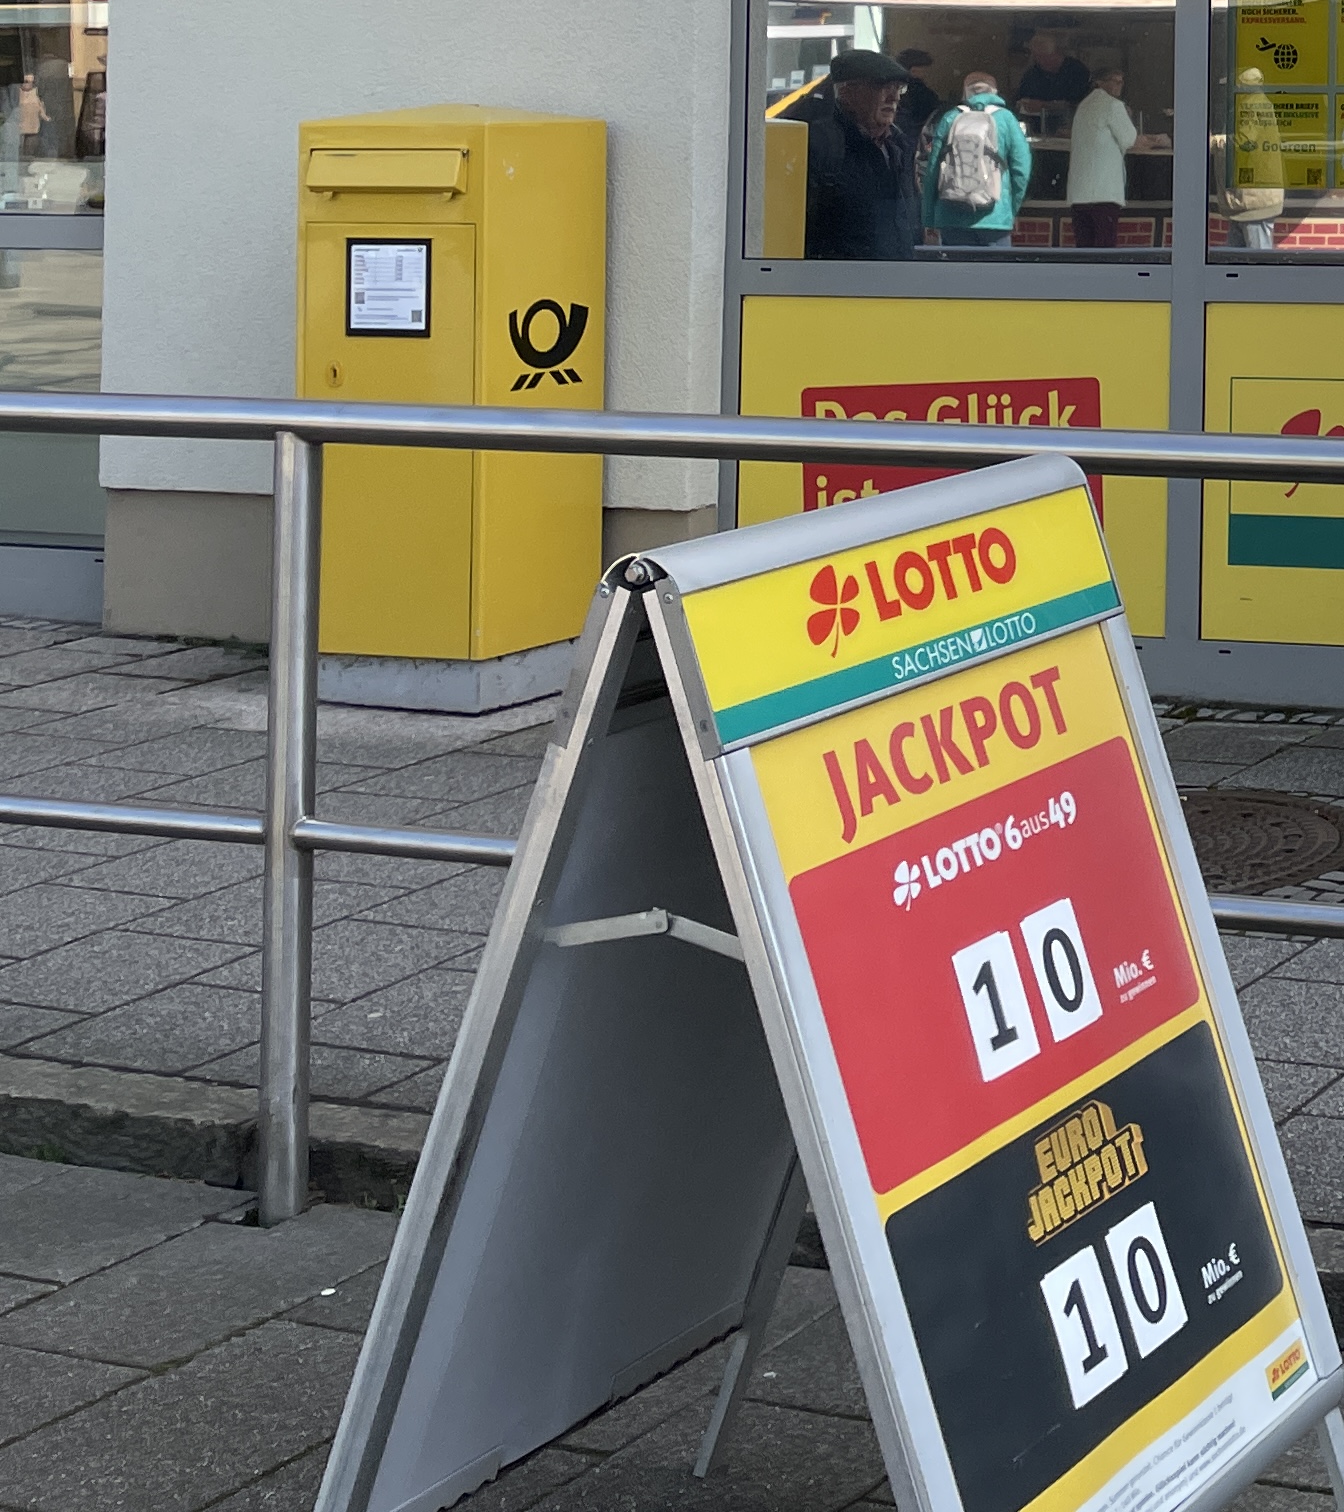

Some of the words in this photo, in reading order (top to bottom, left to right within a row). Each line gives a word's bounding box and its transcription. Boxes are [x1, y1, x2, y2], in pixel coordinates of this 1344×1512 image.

[1262, 141, 1316, 153] GoGreen
[866, 527, 1017, 621] LOTTO
[891, 634, 971, 680] SACHSEN
[986, 612, 1036, 647] LOTTO
[822, 666, 1069, 844] JACKPOT
[1113, 961, 1143, 989] Mio.
[1141, 949, 1154, 970] €
[1034, 1104, 1103, 1185] EURO
[1028, 1131, 1138, 1242] JACKPOT
[1201, 1257, 1230, 1289] Mio.
[1228, 1243, 1240, 1265] €
[1280, 1348, 1301, 1376] LOTTO
